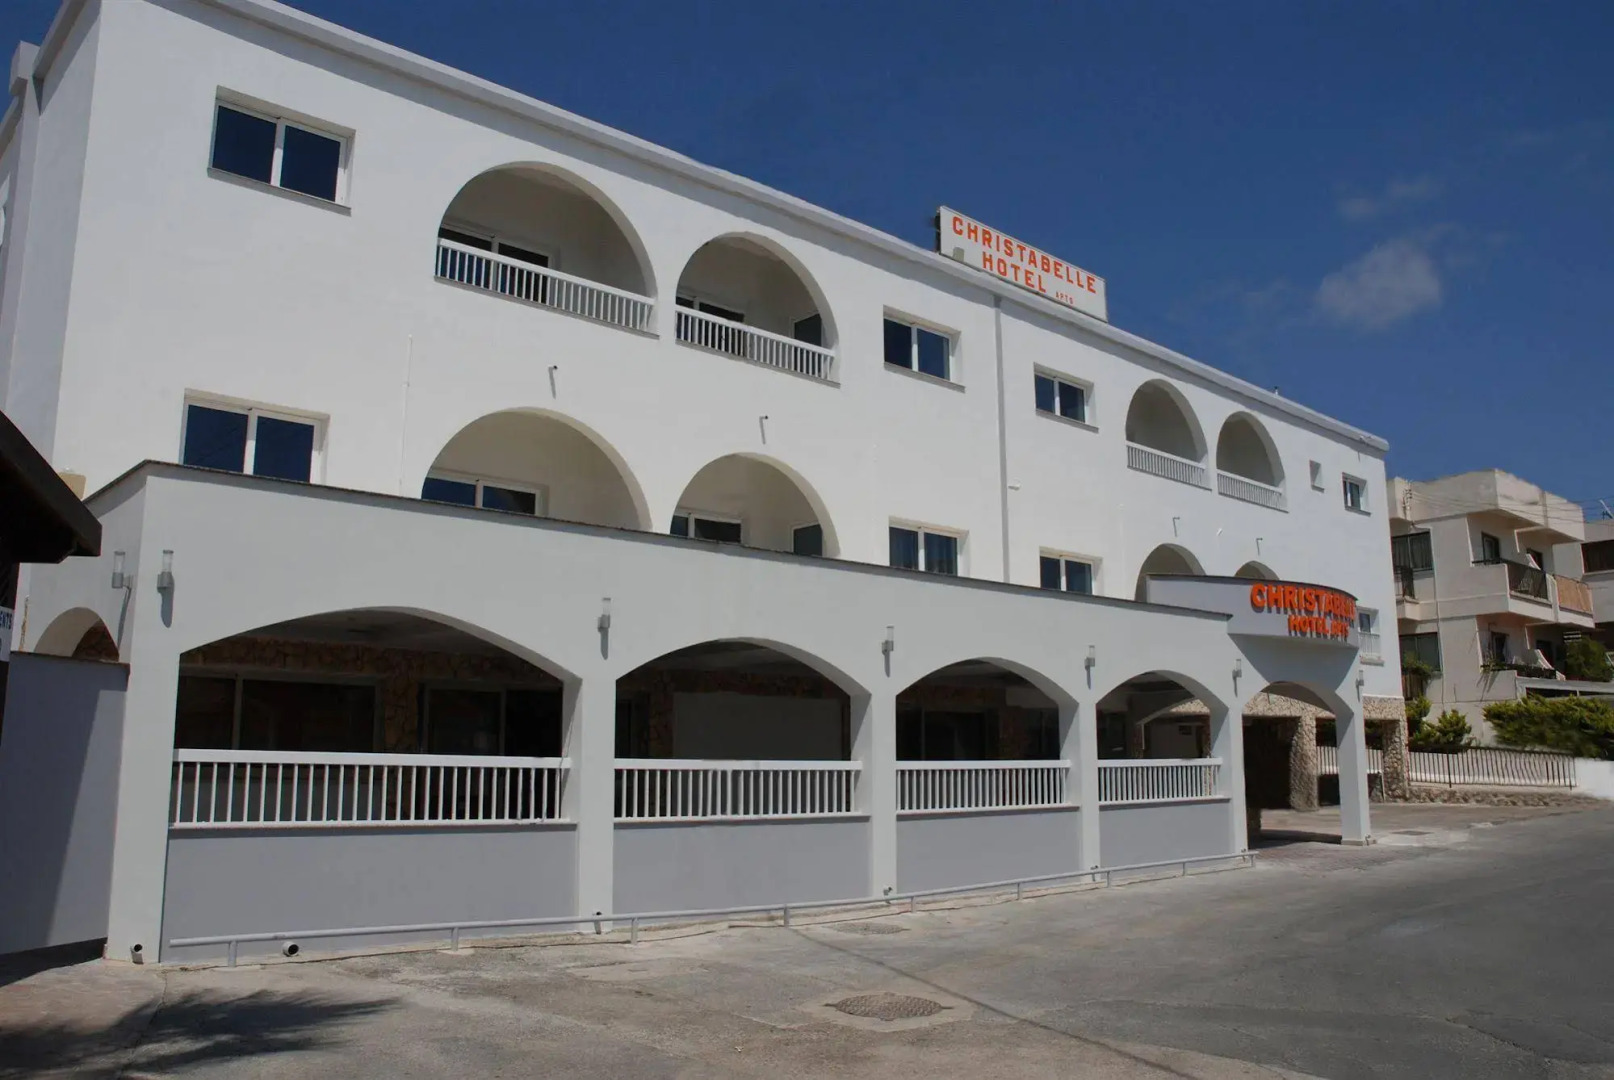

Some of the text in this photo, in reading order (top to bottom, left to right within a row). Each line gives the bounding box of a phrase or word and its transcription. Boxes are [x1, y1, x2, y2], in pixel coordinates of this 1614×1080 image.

[952, 216, 1097, 294] CHRISTABELLE
[982, 251, 1047, 293] HOTEL
[1288, 614, 1329, 635] HOTEL
